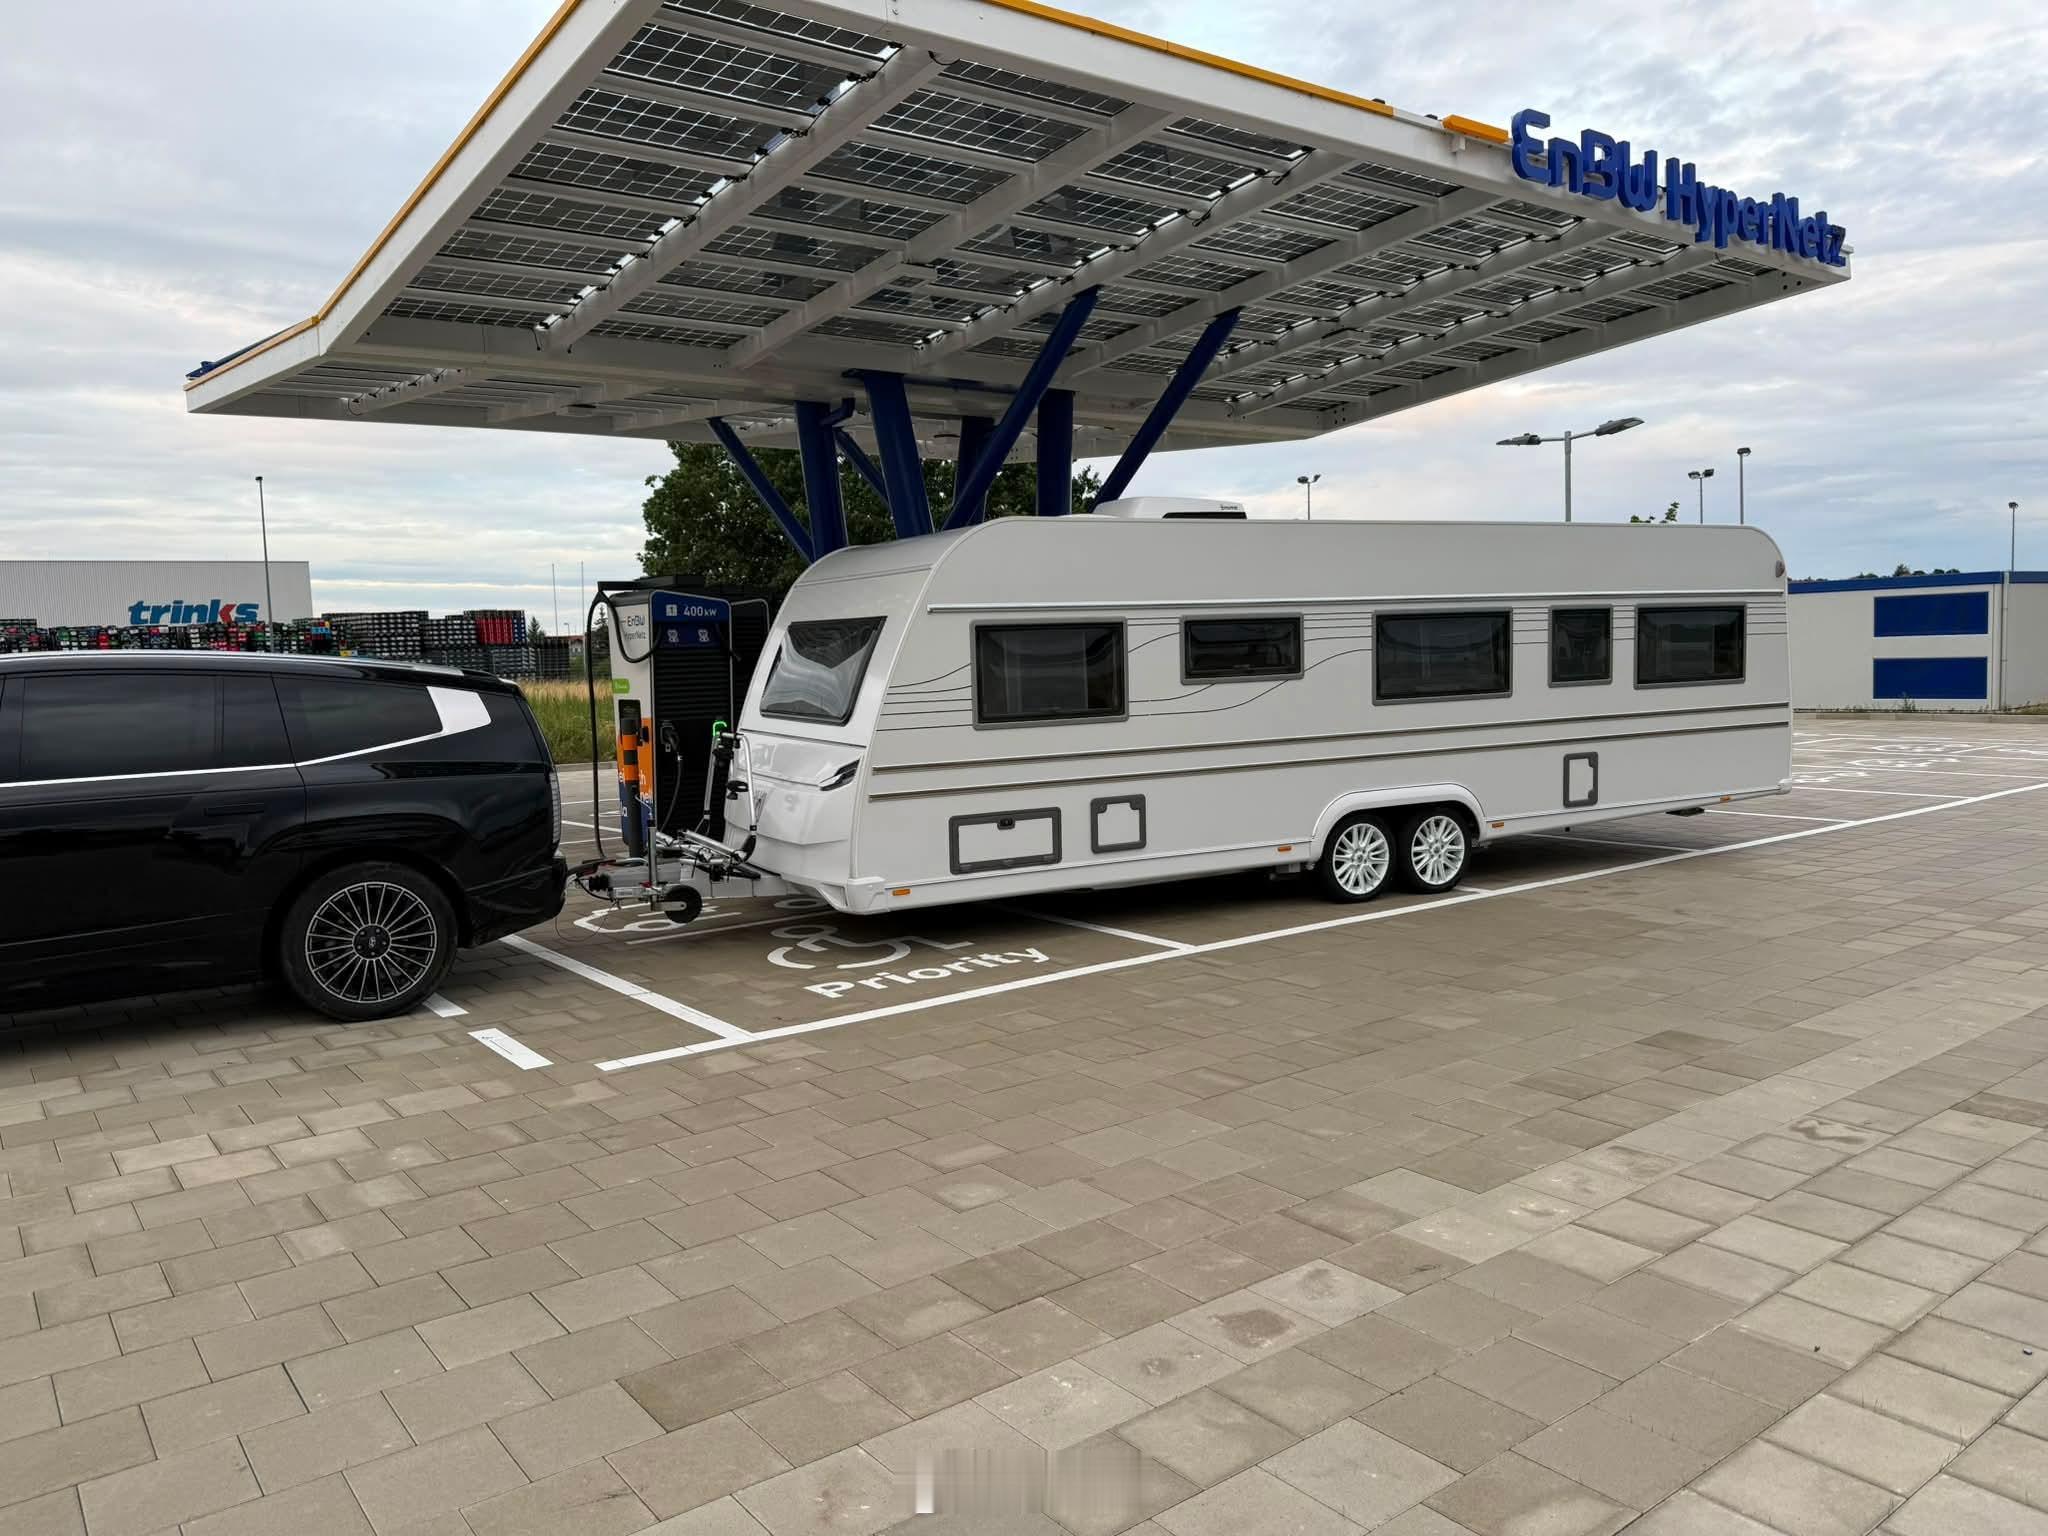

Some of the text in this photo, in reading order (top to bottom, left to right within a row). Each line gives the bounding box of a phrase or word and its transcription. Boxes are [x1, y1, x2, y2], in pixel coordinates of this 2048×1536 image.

[1512, 108, 1846, 267] EnBW HyperNetz
[128, 599, 259, 625] trinks
[803, 947, 1050, 999] Priority
